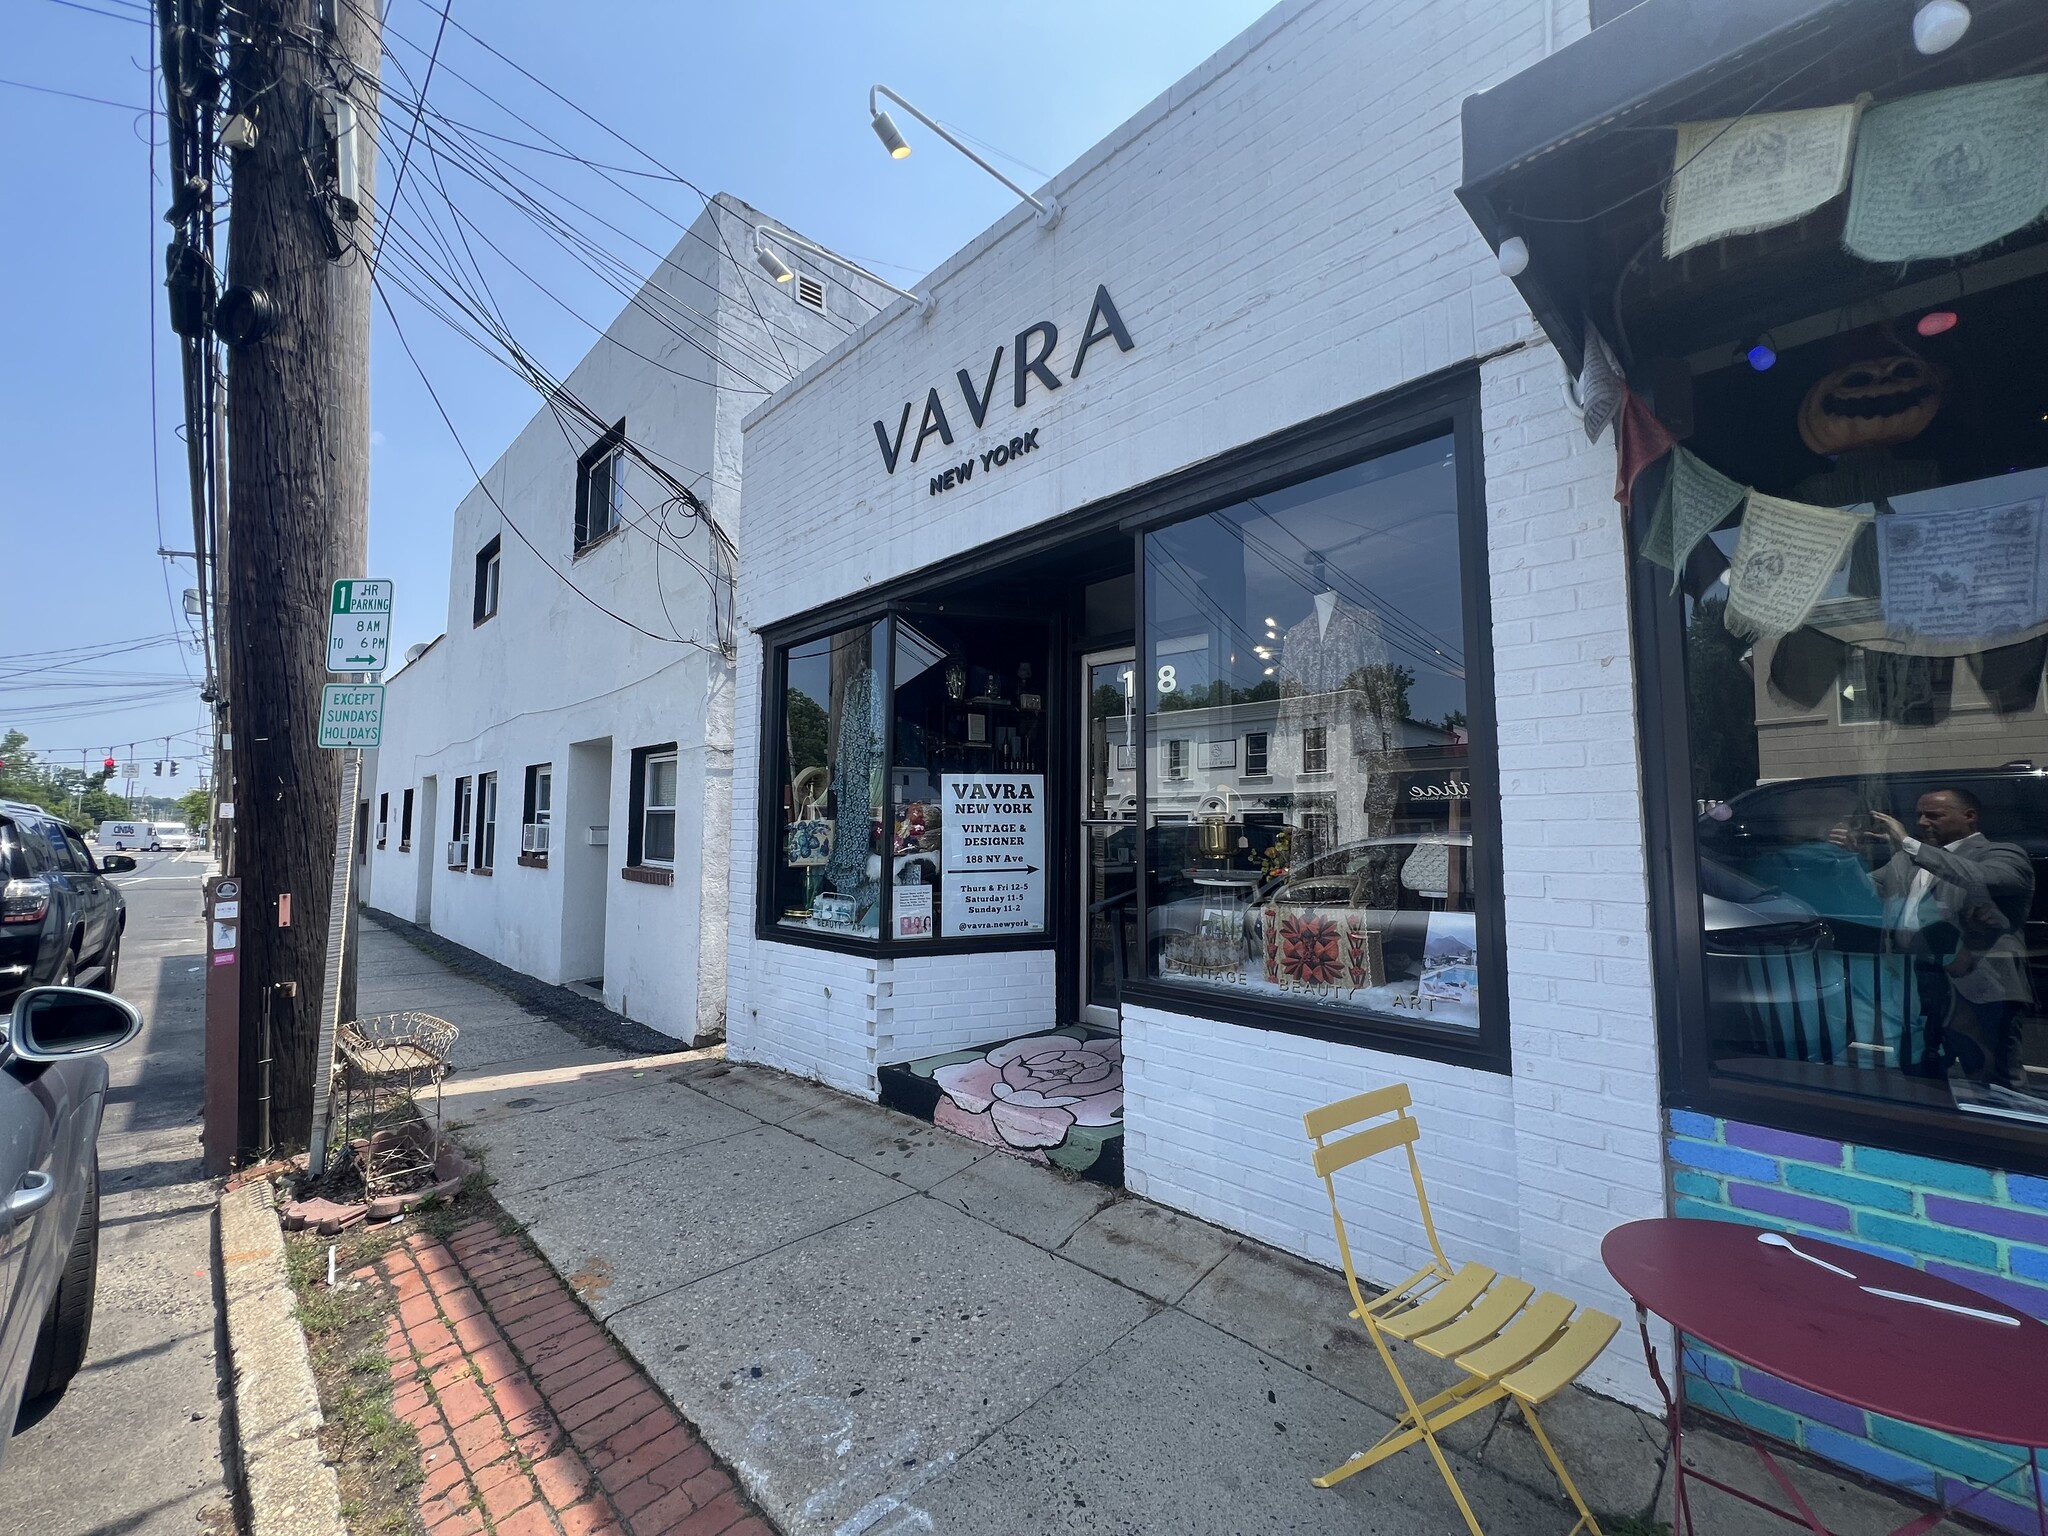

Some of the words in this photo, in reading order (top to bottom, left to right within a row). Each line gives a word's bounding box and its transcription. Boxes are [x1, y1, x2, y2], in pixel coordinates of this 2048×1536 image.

[873, 283, 1135, 475] VAVRA
[929, 459, 975, 496] NEW
[980, 427, 1040, 473] YORK
[364, 584, 378, 596] HR
[339, 586, 347, 609] 1
[351, 598, 389, 611] PARKING
[356, 620, 365, 632] 8
[366, 620, 380, 632] AM
[333, 637, 344, 650] TO
[360, 637, 368, 649] 6
[372, 637, 385, 649] PM
[333, 693, 376, 706] EXCEPT
[327, 710, 378, 723] SUNDAYS
[325, 727, 378, 740] HOLIDAYS
[951, 783, 1035, 800] VAVRA
[954, 803, 989, 814] NEW
[993, 803, 1033, 814] YORK
[962, 824, 1017, 833] VINTAGE
[1019, 824, 1027, 833] &
[964, 837, 1025, 847] DESIGNER
[966, 855, 983, 864] 188
[985, 854, 1001, 863] NY
[1003, 854, 1024, 863] Ave
[960, 885, 986, 893] Thurs
[988, 884, 995, 892] &
[997, 883, 1009, 891] Fri
[1011, 883, 1029, 891] 12-5
[965, 894, 1005, 903] Saturday
[968, 905, 1001, 914] Sunday
[1003, 904, 1021, 912] 11-2
[817, 920, 842, 930] BEAUTY
[851, 923, 866, 933] ART
[958, 919, 1029, 931] @vavra.newyork
[1179, 964, 1248, 987] VINTAGE
[1278, 978, 1357, 1001] BEAUTY
[1392, 994, 1437, 1012] ART
